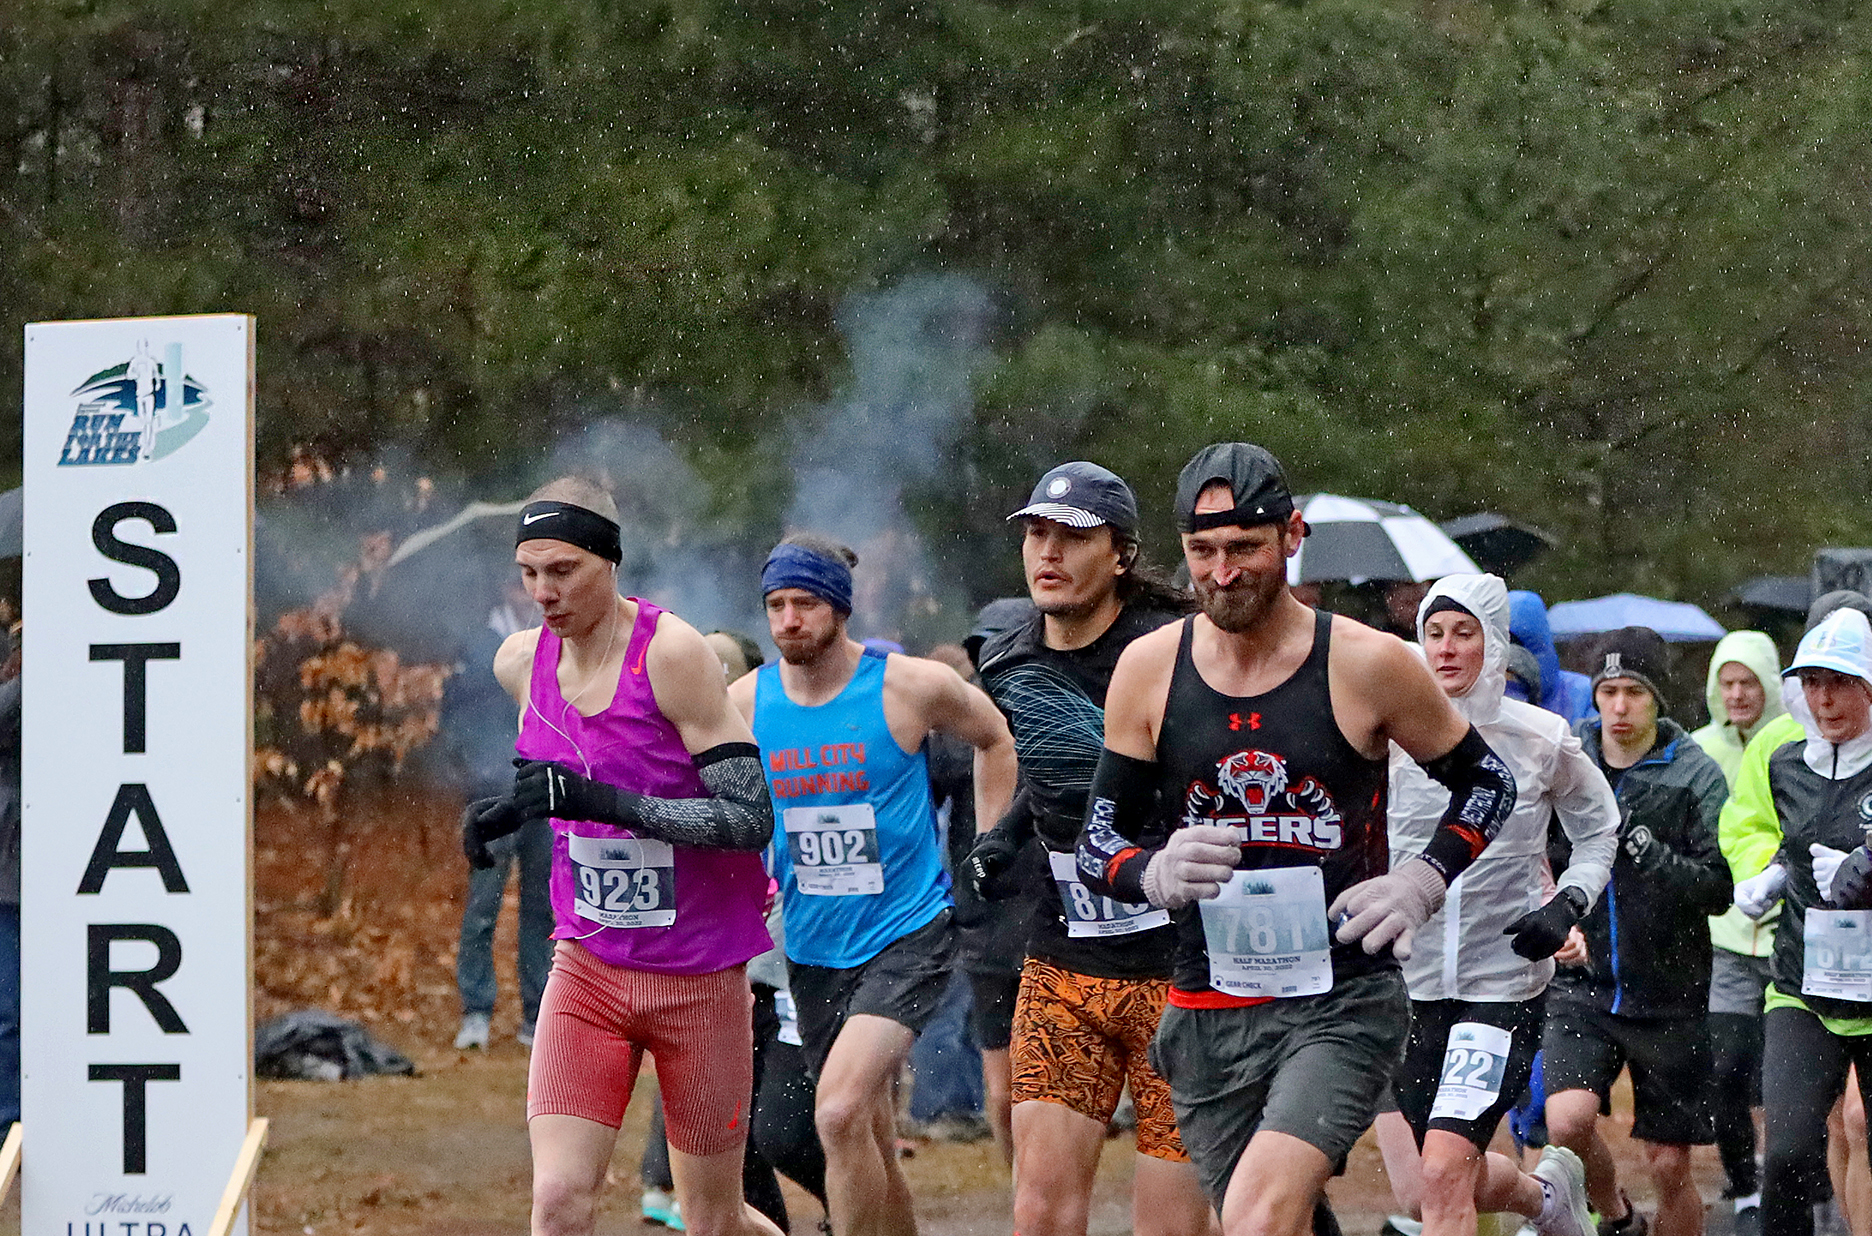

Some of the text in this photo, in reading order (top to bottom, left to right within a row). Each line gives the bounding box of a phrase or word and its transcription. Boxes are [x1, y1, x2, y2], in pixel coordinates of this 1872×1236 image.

[770, 743, 866, 772] MILL CITY
[772, 771, 870, 799] RUNNING
[76, 501, 191, 1175] START
[800, 831, 868, 866] 902
[579, 866, 660, 911] 923
[1222, 904, 1304, 954] 781
[1233, 955, 1301, 965] HALF MARATHON
[85, 1193, 172, 1216] Michelob
